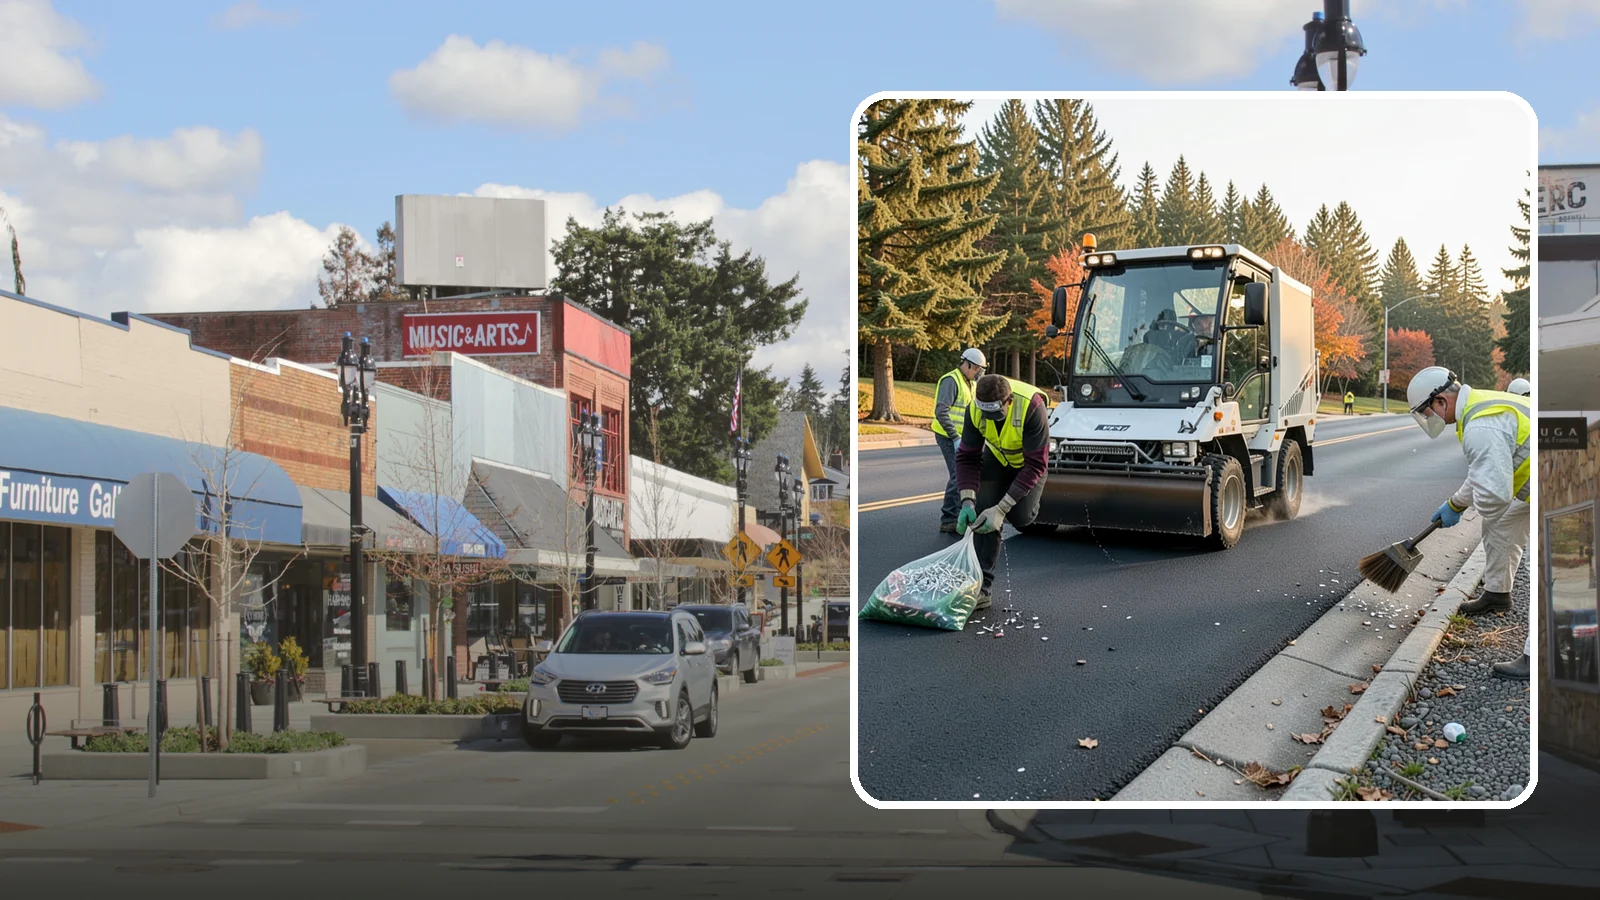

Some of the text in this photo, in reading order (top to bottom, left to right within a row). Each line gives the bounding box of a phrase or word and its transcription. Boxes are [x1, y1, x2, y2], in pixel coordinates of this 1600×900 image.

[409, 323, 520, 349] MUSIC&ARTS
[0, 471, 122, 519] Furniture Gal
[453, 563, 480, 574] SUSHI
